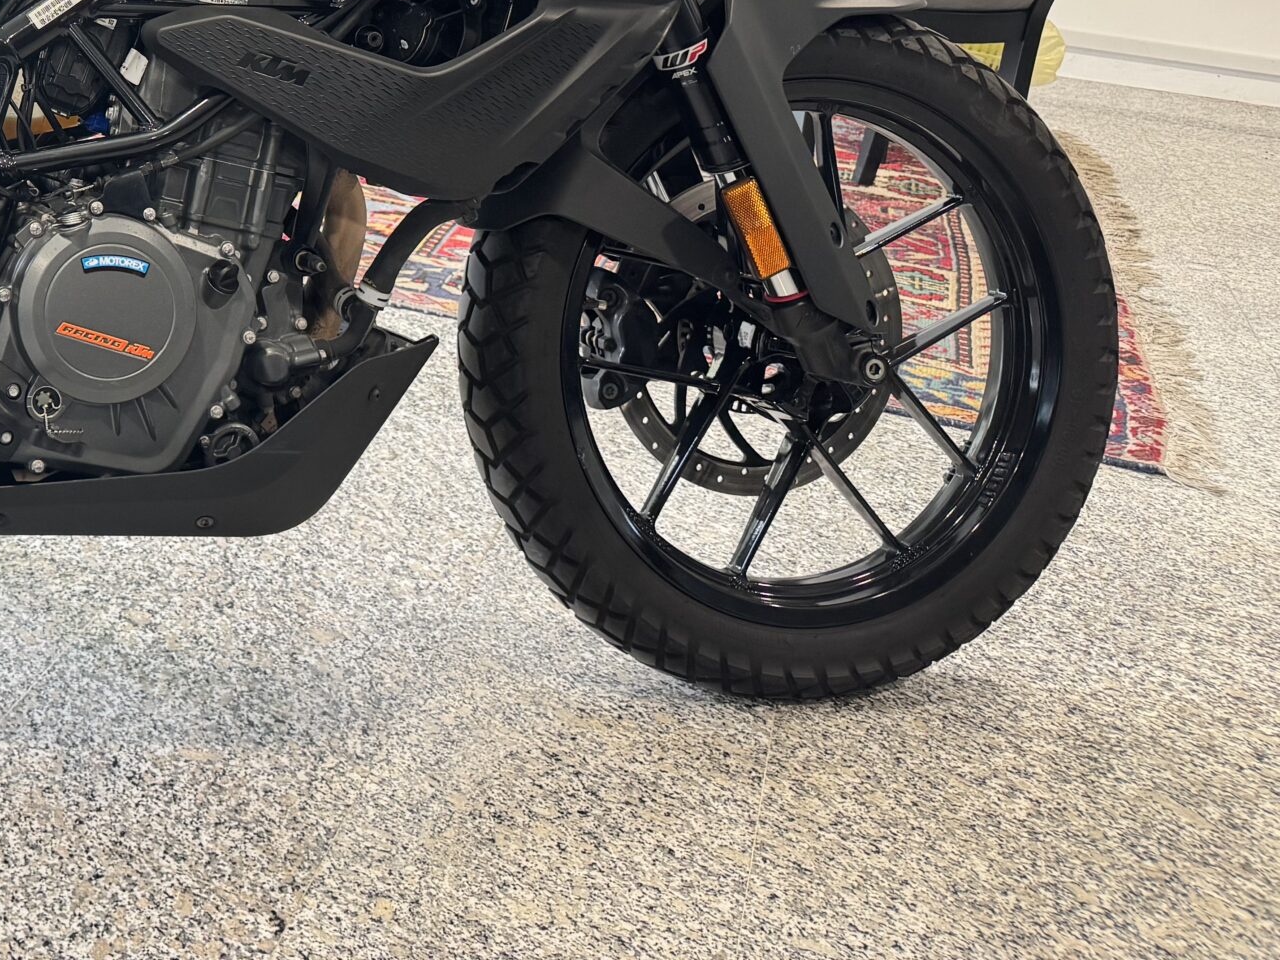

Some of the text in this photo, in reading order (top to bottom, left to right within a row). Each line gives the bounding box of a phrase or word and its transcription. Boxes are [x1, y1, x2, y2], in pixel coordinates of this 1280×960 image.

[235, 51, 311, 87] KTM
[660, 38, 708, 71] WP
[671, 66, 699, 80] APEX
[99, 256, 145, 271] MOTOREX
[62, 325, 155, 360] RACING KTM
